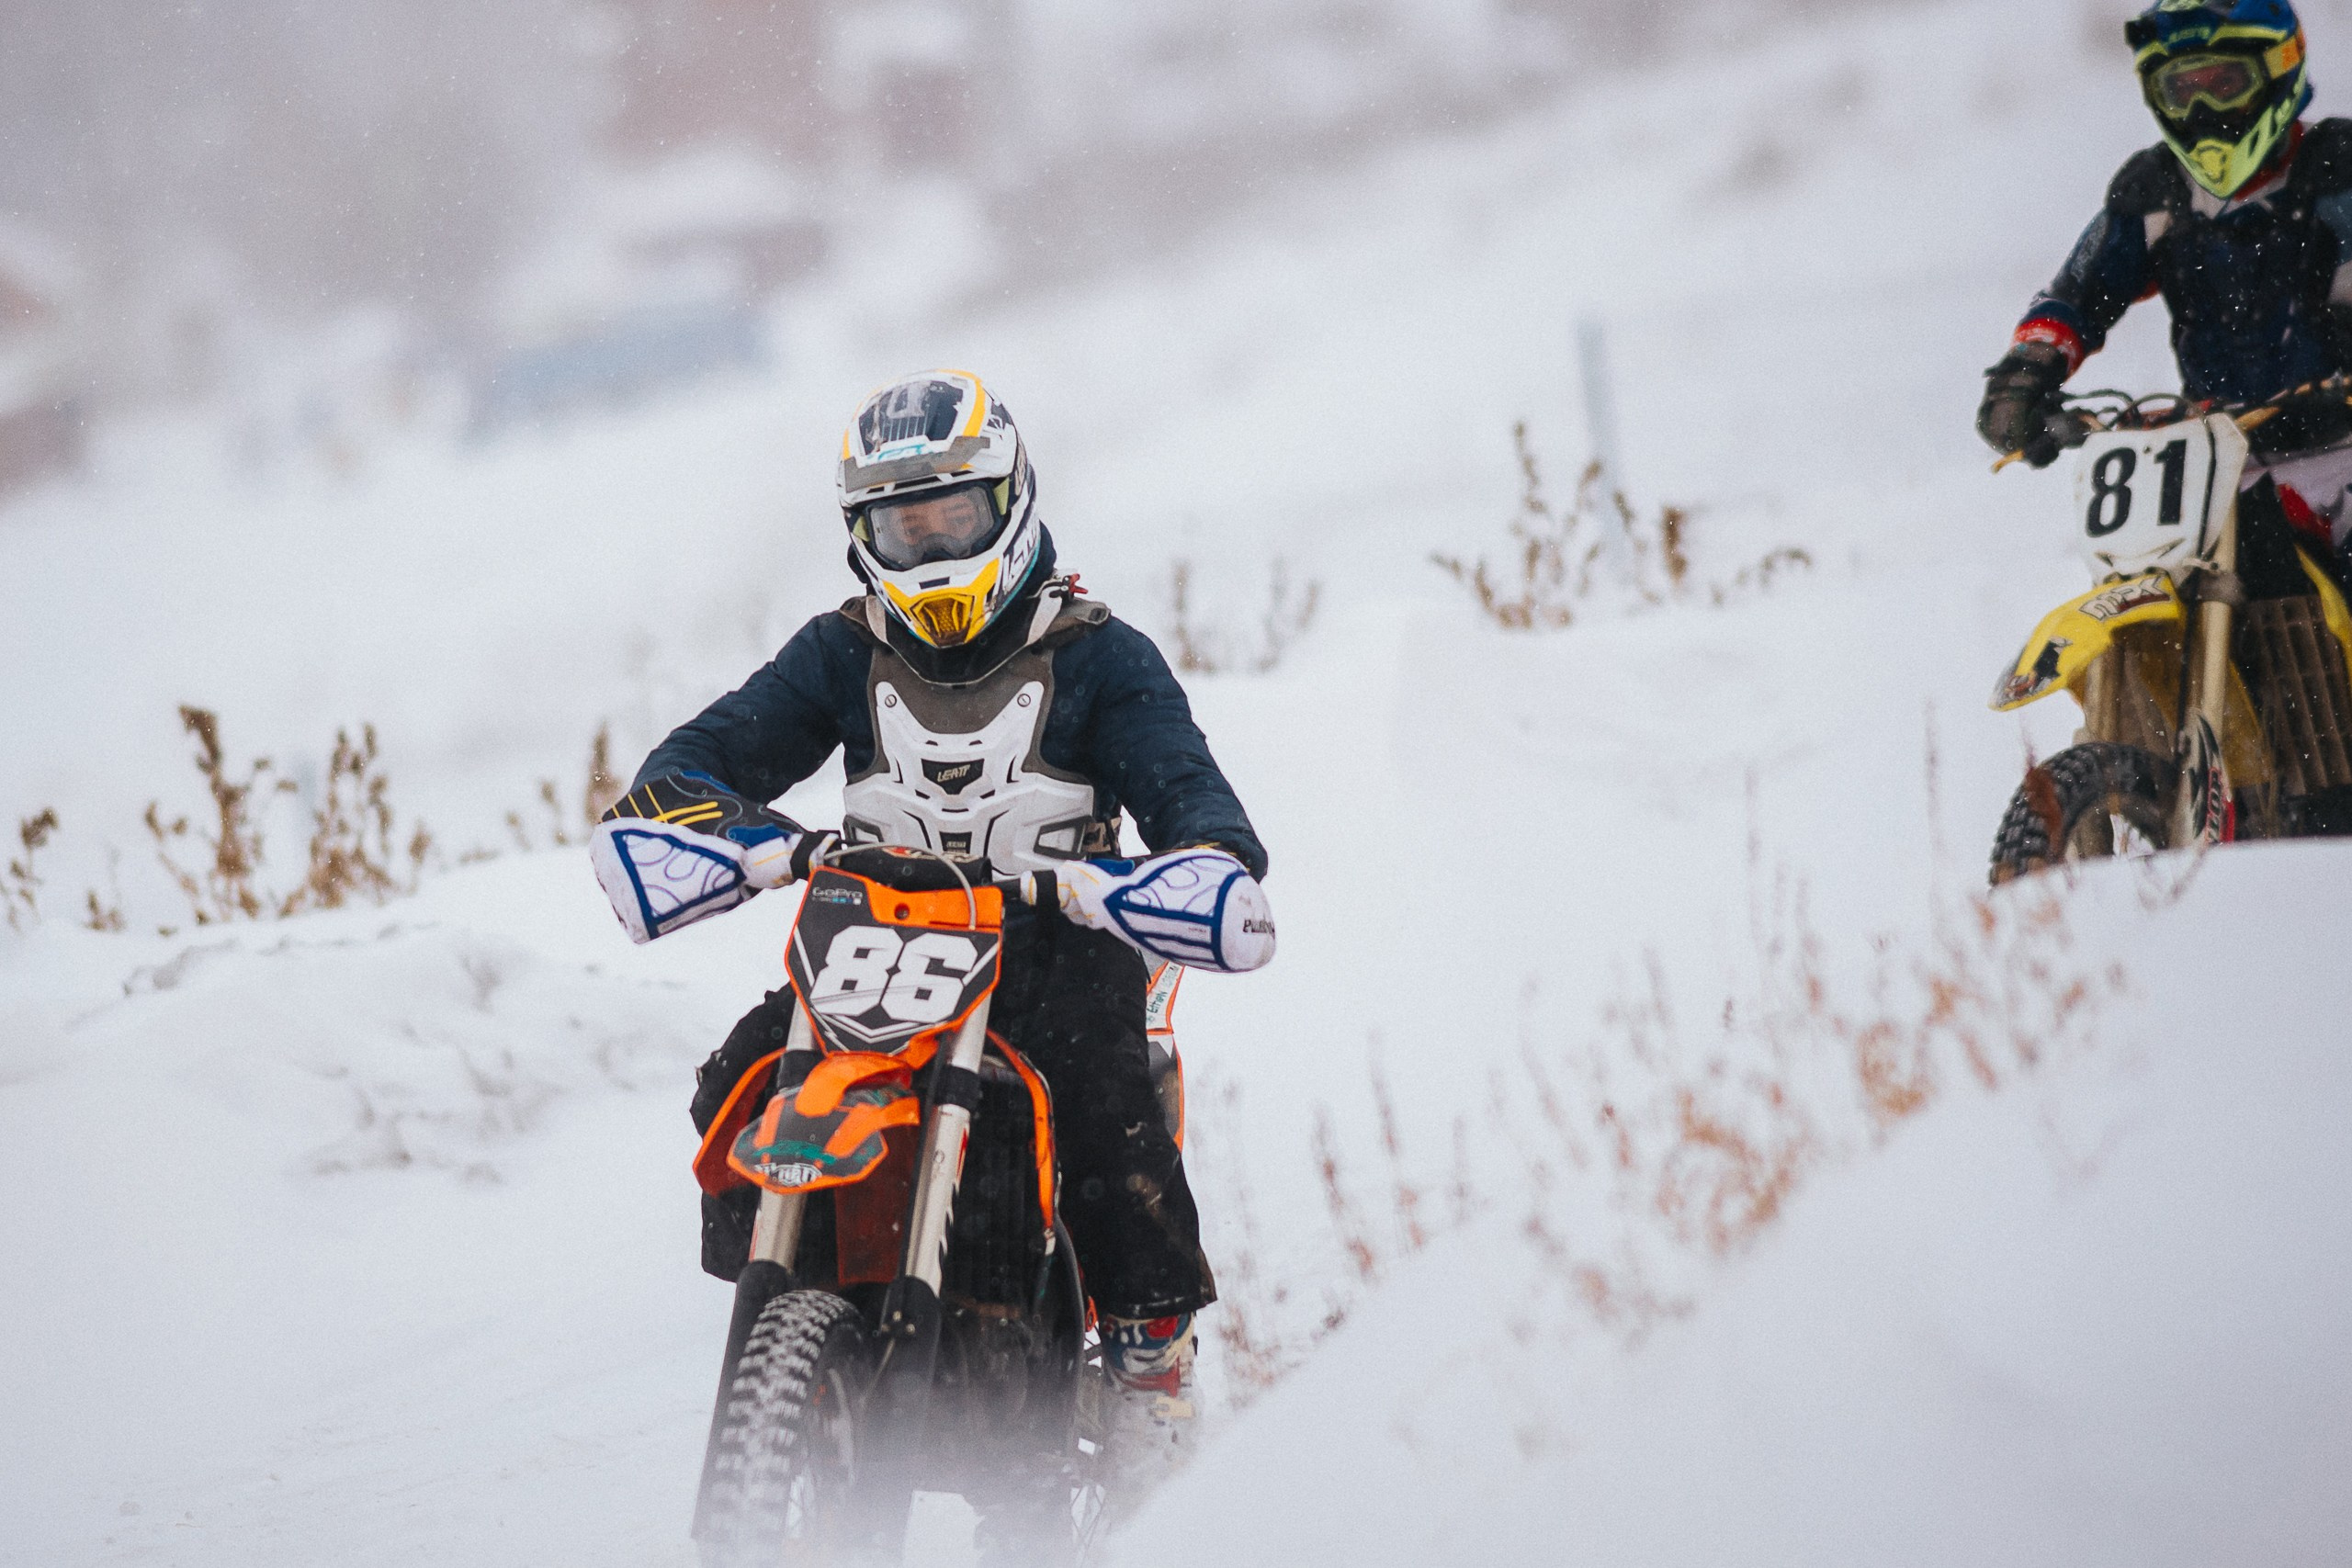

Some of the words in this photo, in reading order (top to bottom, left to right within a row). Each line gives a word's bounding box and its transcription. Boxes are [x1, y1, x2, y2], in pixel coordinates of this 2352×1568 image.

[2085, 438, 2188, 538] 81
[812, 886, 864, 899] GoPro
[809, 925, 978, 1023] 86
